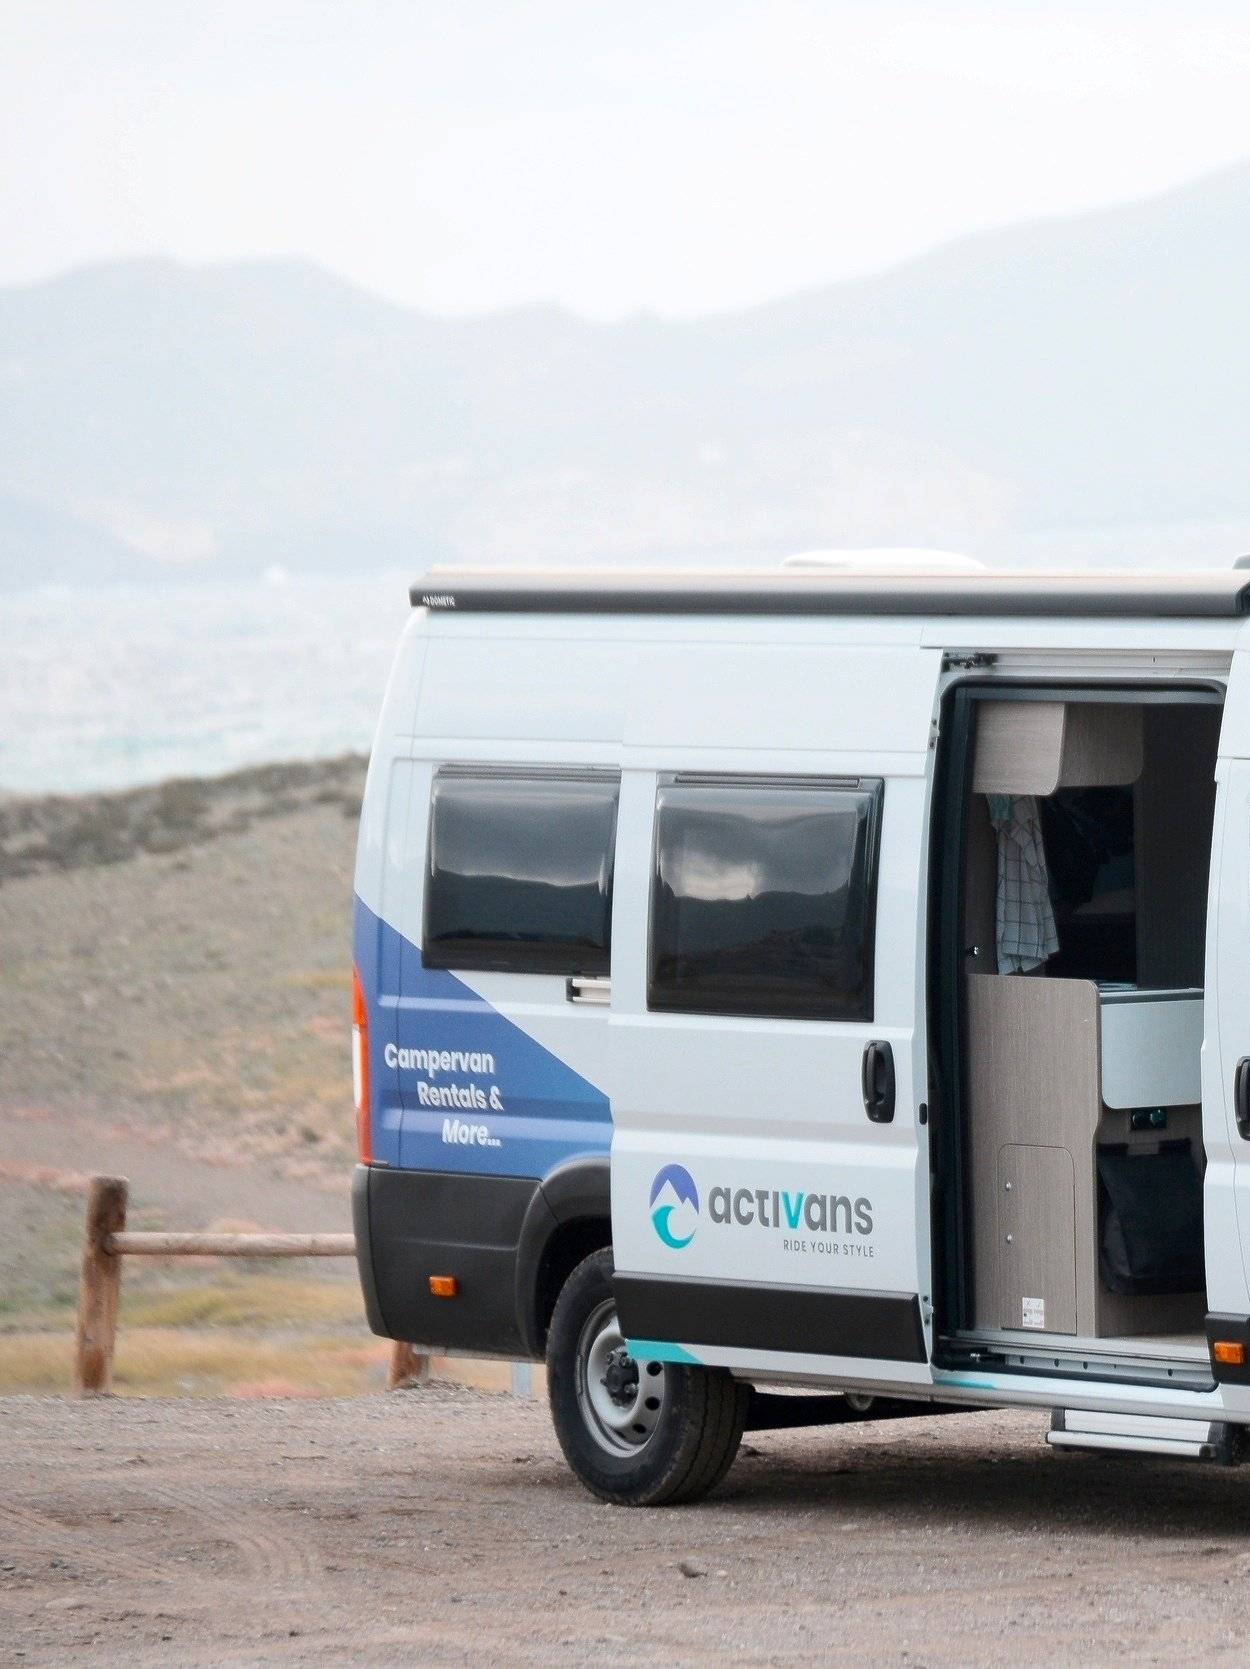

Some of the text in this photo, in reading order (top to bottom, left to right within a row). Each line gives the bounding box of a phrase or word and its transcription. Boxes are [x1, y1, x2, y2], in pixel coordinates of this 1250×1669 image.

[384, 1043, 496, 1078] Campervan
[417, 1081, 504, 1110] Rentals &
[442, 1119, 502, 1147] More...
[783, 1239, 875, 1258] RIDE YOUR STYLE
